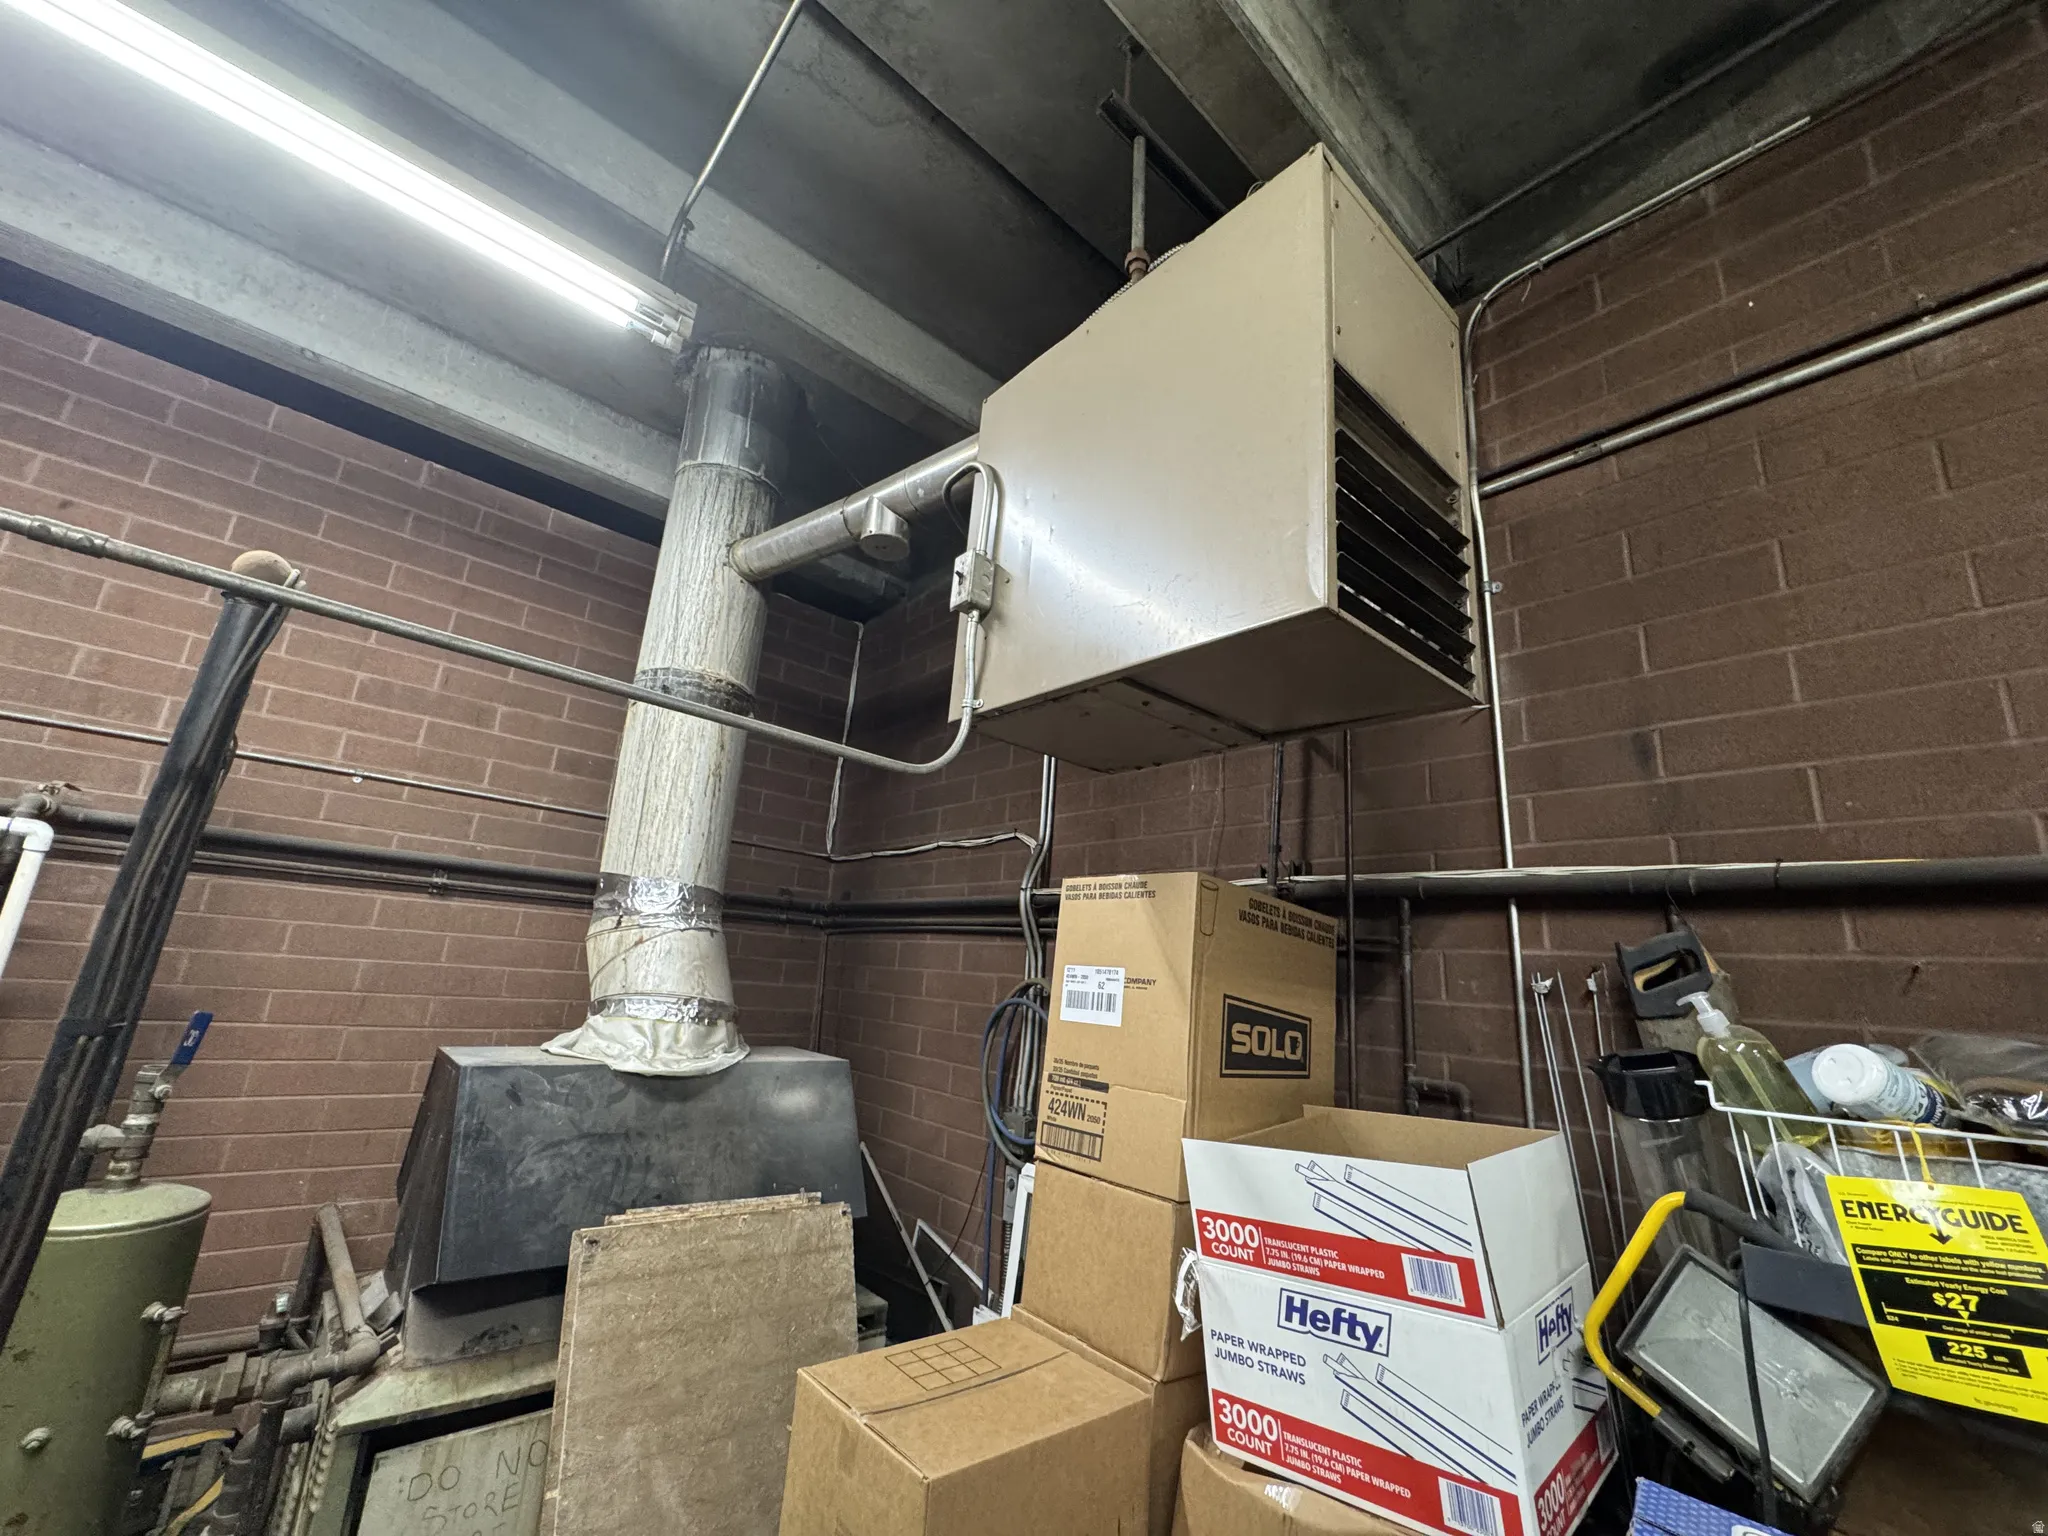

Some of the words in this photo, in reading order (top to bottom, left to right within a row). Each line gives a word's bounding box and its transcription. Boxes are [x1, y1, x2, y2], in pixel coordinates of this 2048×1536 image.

[1065, 883, 1092, 892] GOBELETS
[1098, 882, 1123, 891] BOISSON
[1124, 880, 1148, 890] CHAUDE
[1082, 892, 1097, 900] PARA
[1098, 891, 1122, 900] BEBIDAS
[1124, 890, 1156, 899] CALIENTES
[1238, 908, 1260, 927] VASOS
[1261, 916, 1279, 932] PARA
[1280, 921, 1305, 940] BEBIDAS
[1306, 930, 1335, 949] CALIENTES
[1248, 897, 1280, 918] GOBELETS
[1288, 910, 1313, 928] BOISSON
[1313, 919, 1335, 936] CHAUDE
[1098, 981, 1105, 990] 62
[1231, 1022, 1303, 1060] SOLO
[1048, 1097, 1086, 1121] 424WN
[1087, 1115, 1100, 1124] 2050
[1201, 1216, 1259, 1248] 3000
[1211, 1242, 1255, 1262] COUNT
[1264, 1237, 1309, 1253] TRANSLUCENT
[1310, 1246, 1339, 1260] PLASTIC
[1265, 1247, 1279, 1257] 7.75
[1280, 1250, 1290, 1260] IN.
[1291, 1252, 1308, 1264] (19.6
[1309, 1256, 1323, 1268] CM)
[1324, 1259, 1347, 1272] PAPER
[1347, 1264, 1385, 1279] WRAPPED
[1855, 1247, 1888, 1258] Compare
[1888, 1250, 1908, 1259] ONLY
[1909, 1252, 1918, 1260] to
[1919, 1253, 1939, 1262] other
[1939, 1255, 1962, 1264] labels
[1962, 1258, 1979, 1267] with
[1979, 1259, 2007, 1270] yellow
[2007, 1263, 2046, 1274] numbers.
[1267, 1257, 1292, 1270] JUMBO
[1292, 1262, 1320, 1277] STRAWS
[1905, 1277, 1940, 1288] Estimated
[1940, 1281, 1962, 1290] Yearly
[1963, 1284, 1989, 1294] Energy
[1989, 1287, 2008, 1296] Cost
[1932, 1292, 1979, 1312] $27
[1285, 1295, 1384, 1351] Hefty
[1538, 1302, 1573, 1352] Hefty
[1210, 1329, 1245, 1349] PAPER
[1247, 1339, 1306, 1368] WRAPPED
[1947, 1341, 1988, 1360] 225
[1215, 1347, 1254, 1369] JUMBO
[1258, 1361, 1306, 1385] STRAWS
[1218, 1398, 1278, 1442] 3000
[1520, 1398, 1537, 1428] PAPER
[1527, 1414, 1546, 1448] JUMBO
[1545, 1395, 1565, 1423] STRAWS
[1227, 1428, 1272, 1456] COUNT
[1282, 1431, 1332, 1457] TRANSLUCENT
[1332, 1448, 1363, 1468] PLASTIC
[407, 1465, 461, 1502] DO
[1284, 1443, 1299, 1455] 7.75
[1299, 1448, 1310, 1460] IN.
[1311, 1451, 1329, 1468] (19.6
[1330, 1458, 1346, 1475] CM)
[1346, 1465, 1370, 1483] PAPER
[1371, 1474, 1411, 1499] WRAPPED
[1285, 1456, 1311, 1472] JUMBO
[1312, 1465, 1342, 1485] STRAWS
[422, 1481, 519, 1531] STORE
[1537, 1472, 1565, 1531] 3000
